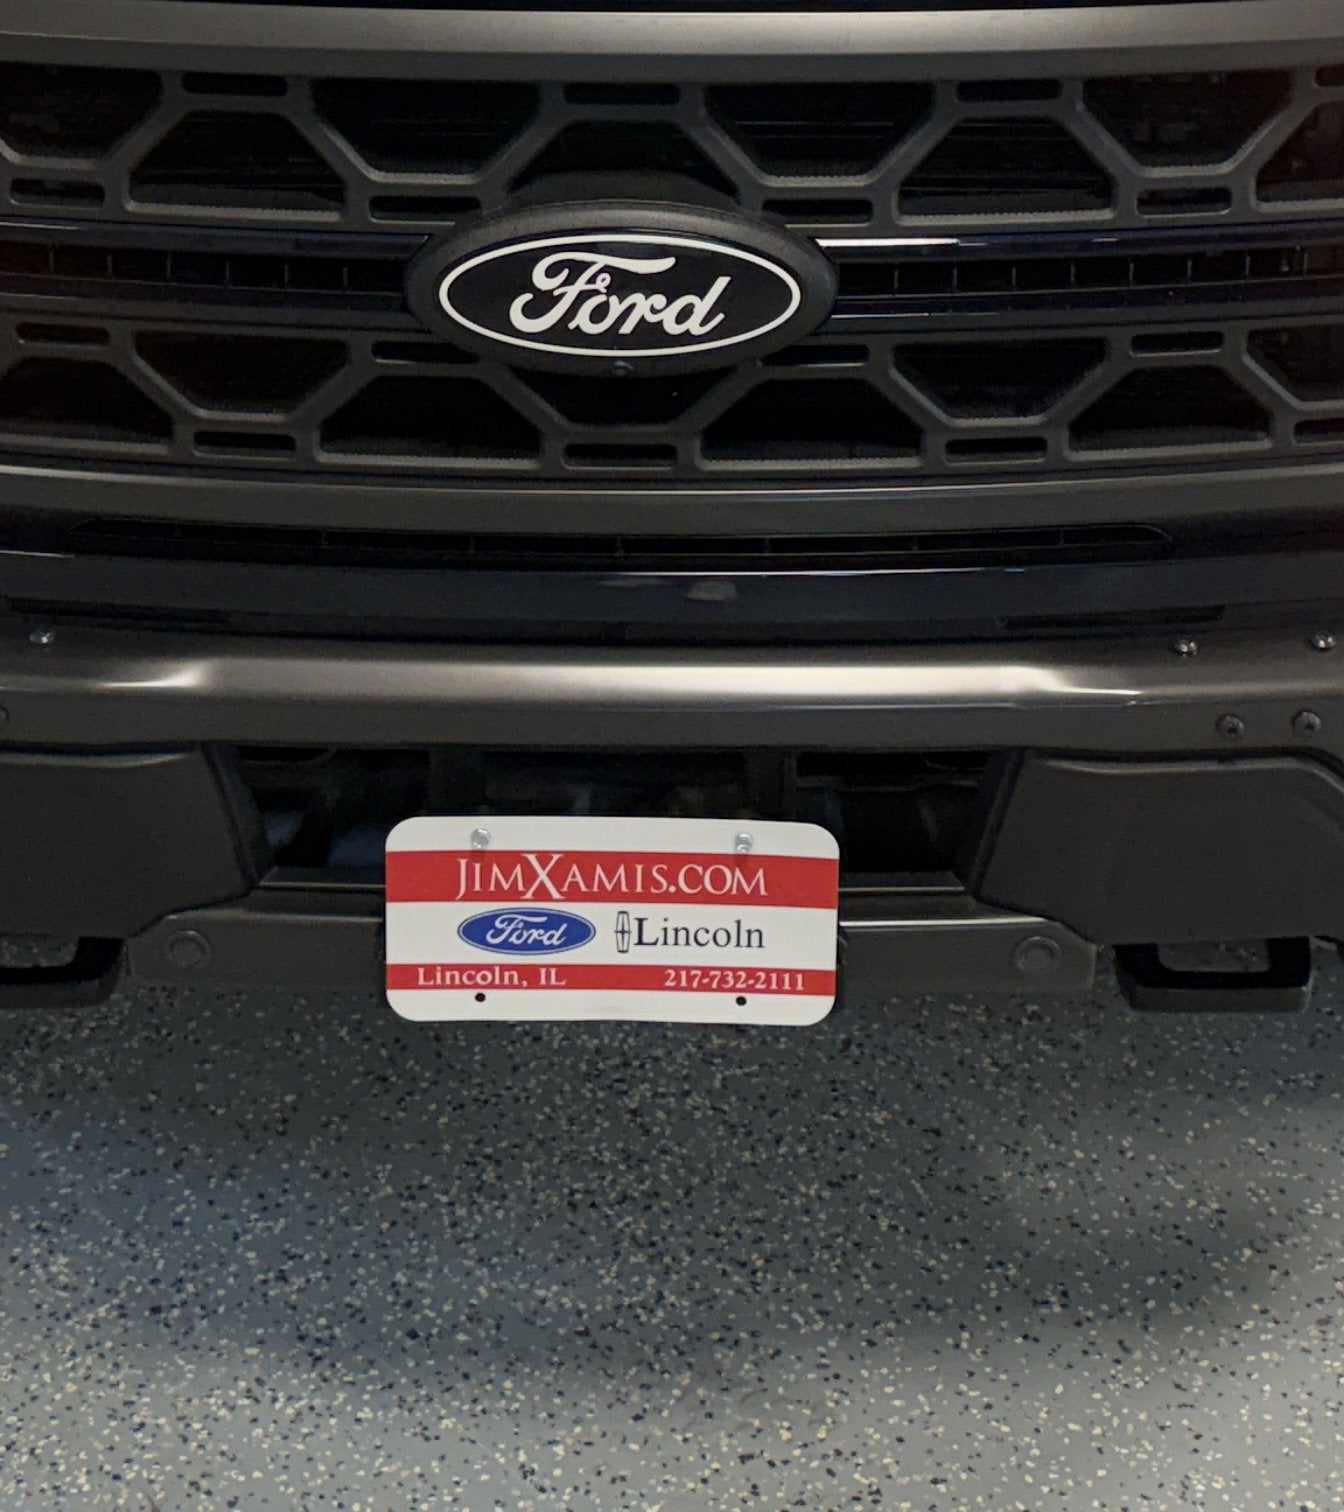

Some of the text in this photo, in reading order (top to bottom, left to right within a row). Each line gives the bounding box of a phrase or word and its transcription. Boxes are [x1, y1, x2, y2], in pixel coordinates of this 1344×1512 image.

[509, 251, 731, 336] Ford
[485, 914, 567, 946] Ford
[633, 917, 766, 949] Lincoln
[417, 965, 566, 988] Lincoln, IL
[664, 968, 806, 991] 217-732-2111
